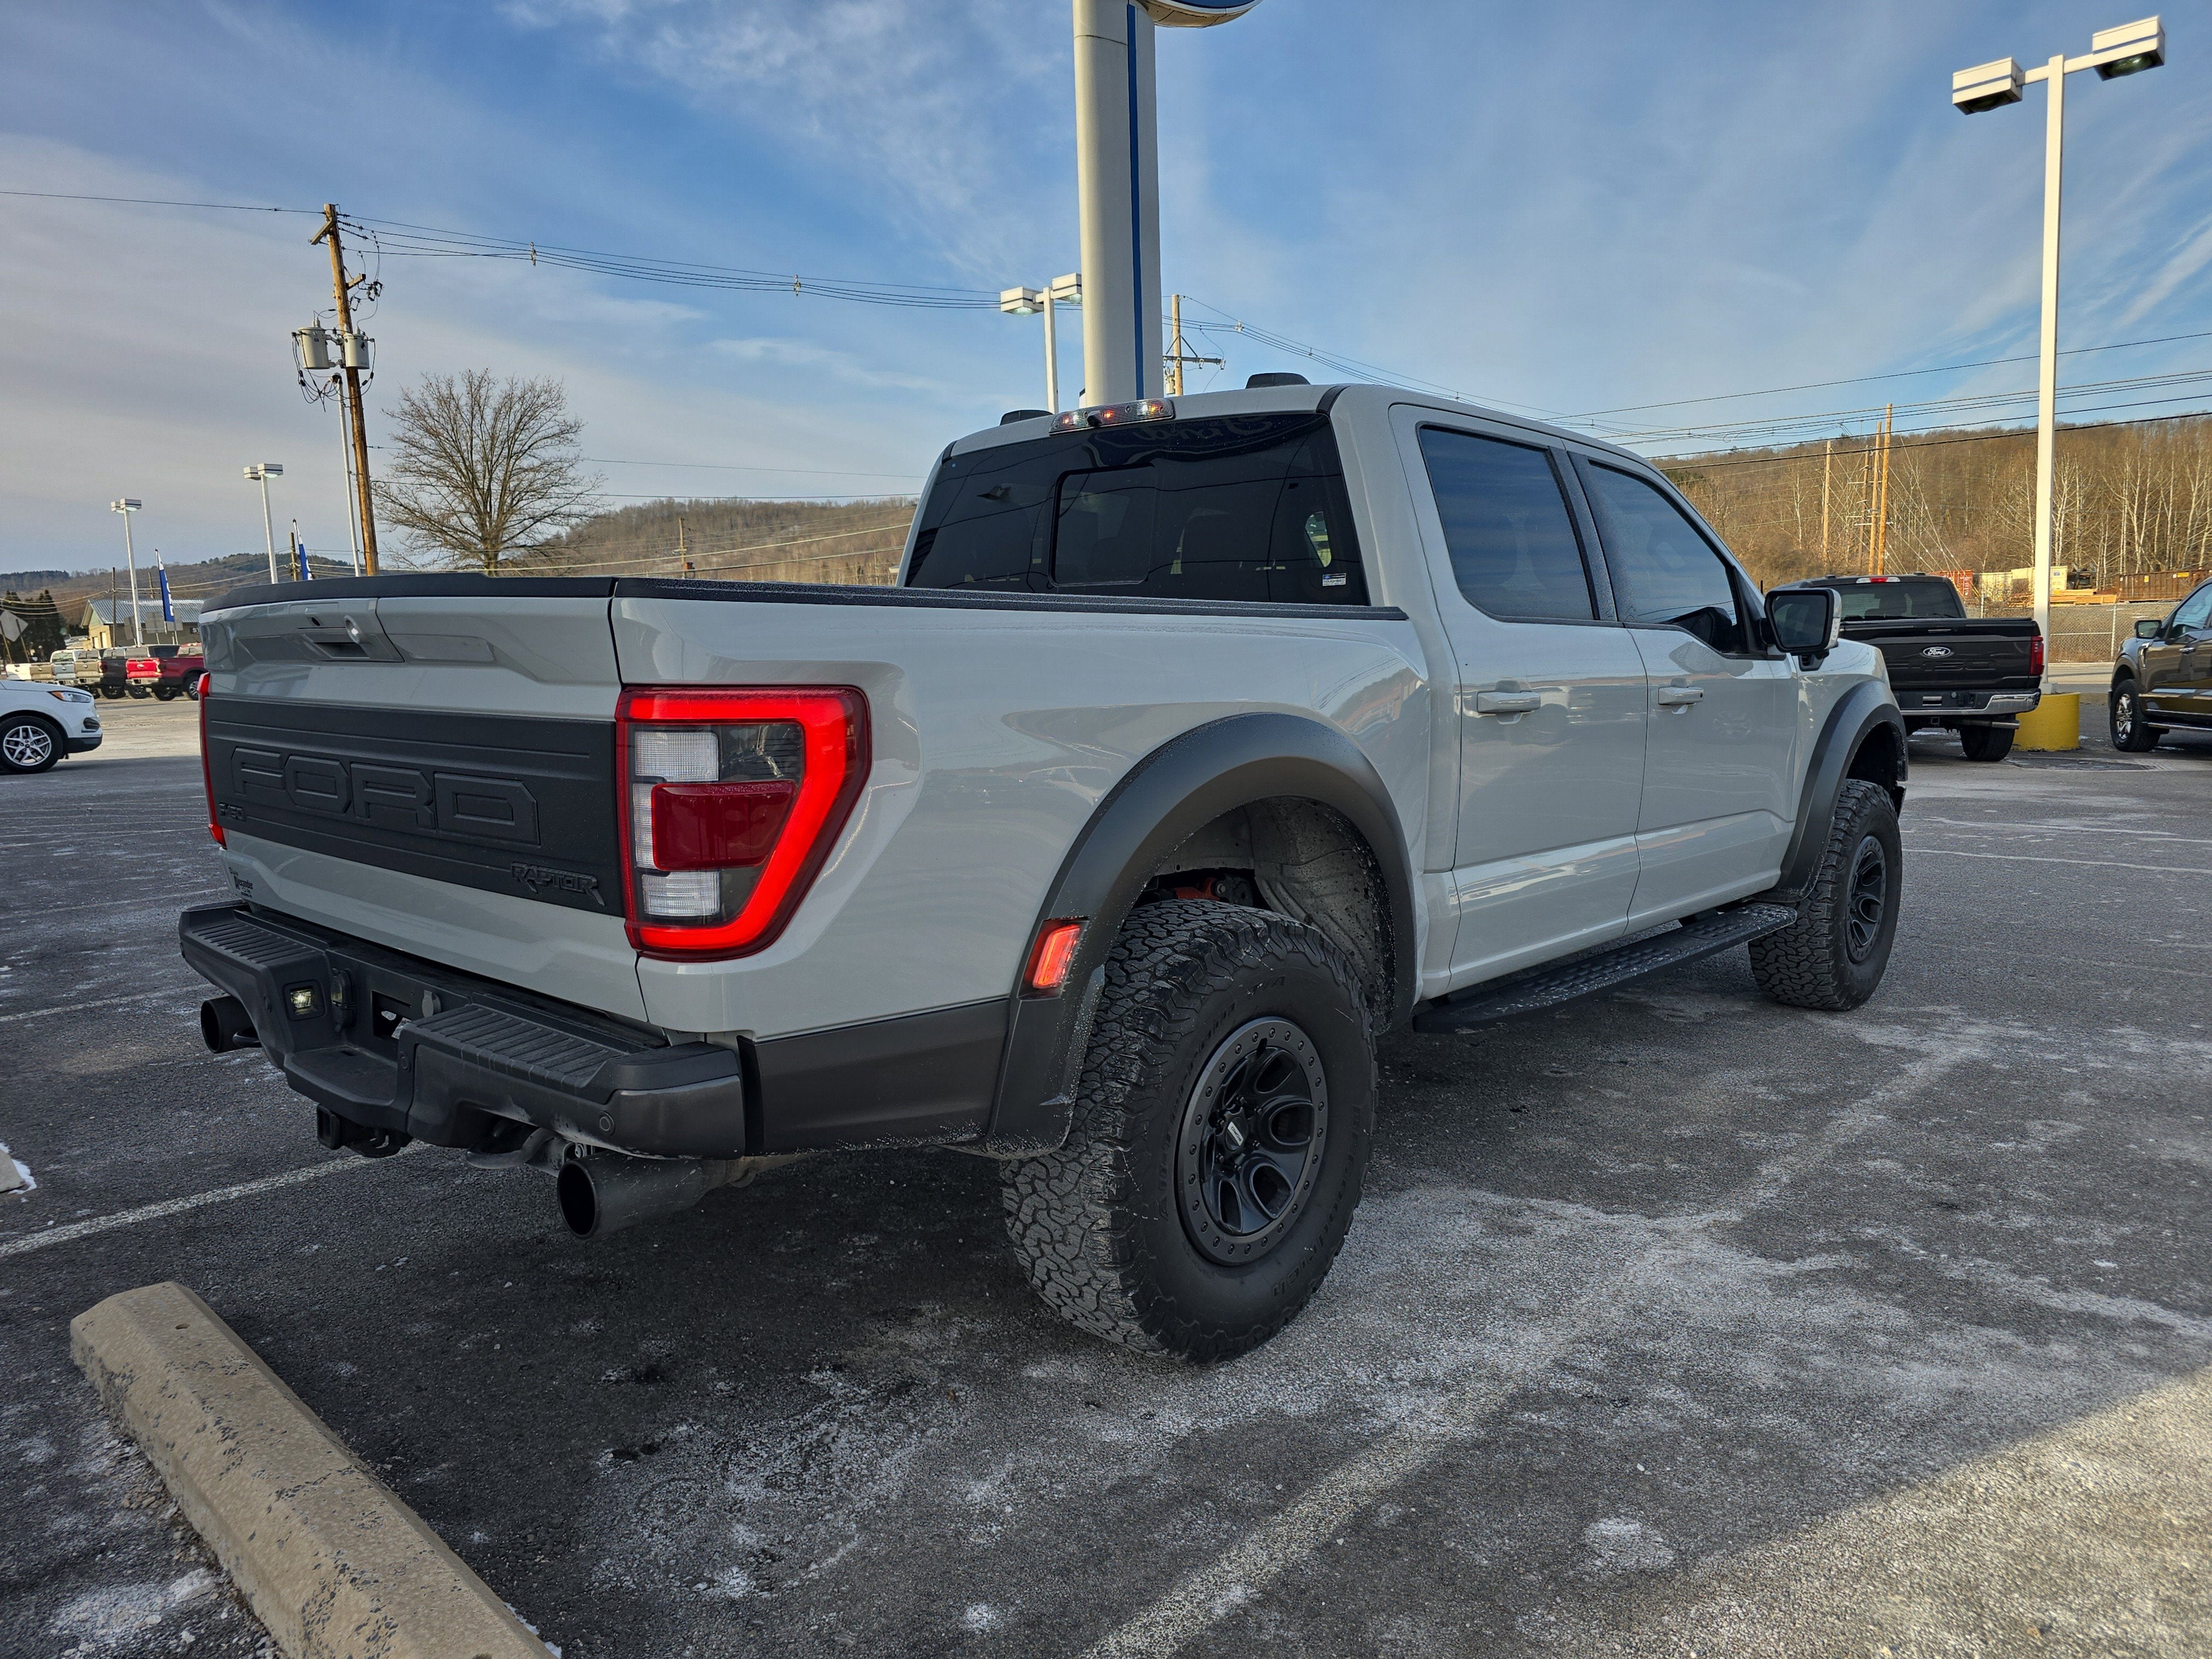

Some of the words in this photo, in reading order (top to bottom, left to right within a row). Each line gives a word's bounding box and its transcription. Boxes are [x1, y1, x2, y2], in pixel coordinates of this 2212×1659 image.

[231, 747, 541, 846] FORD
[511, 861, 605, 907] RAPTOR
[1273, 1105, 1361, 1297] BFGoodrich
